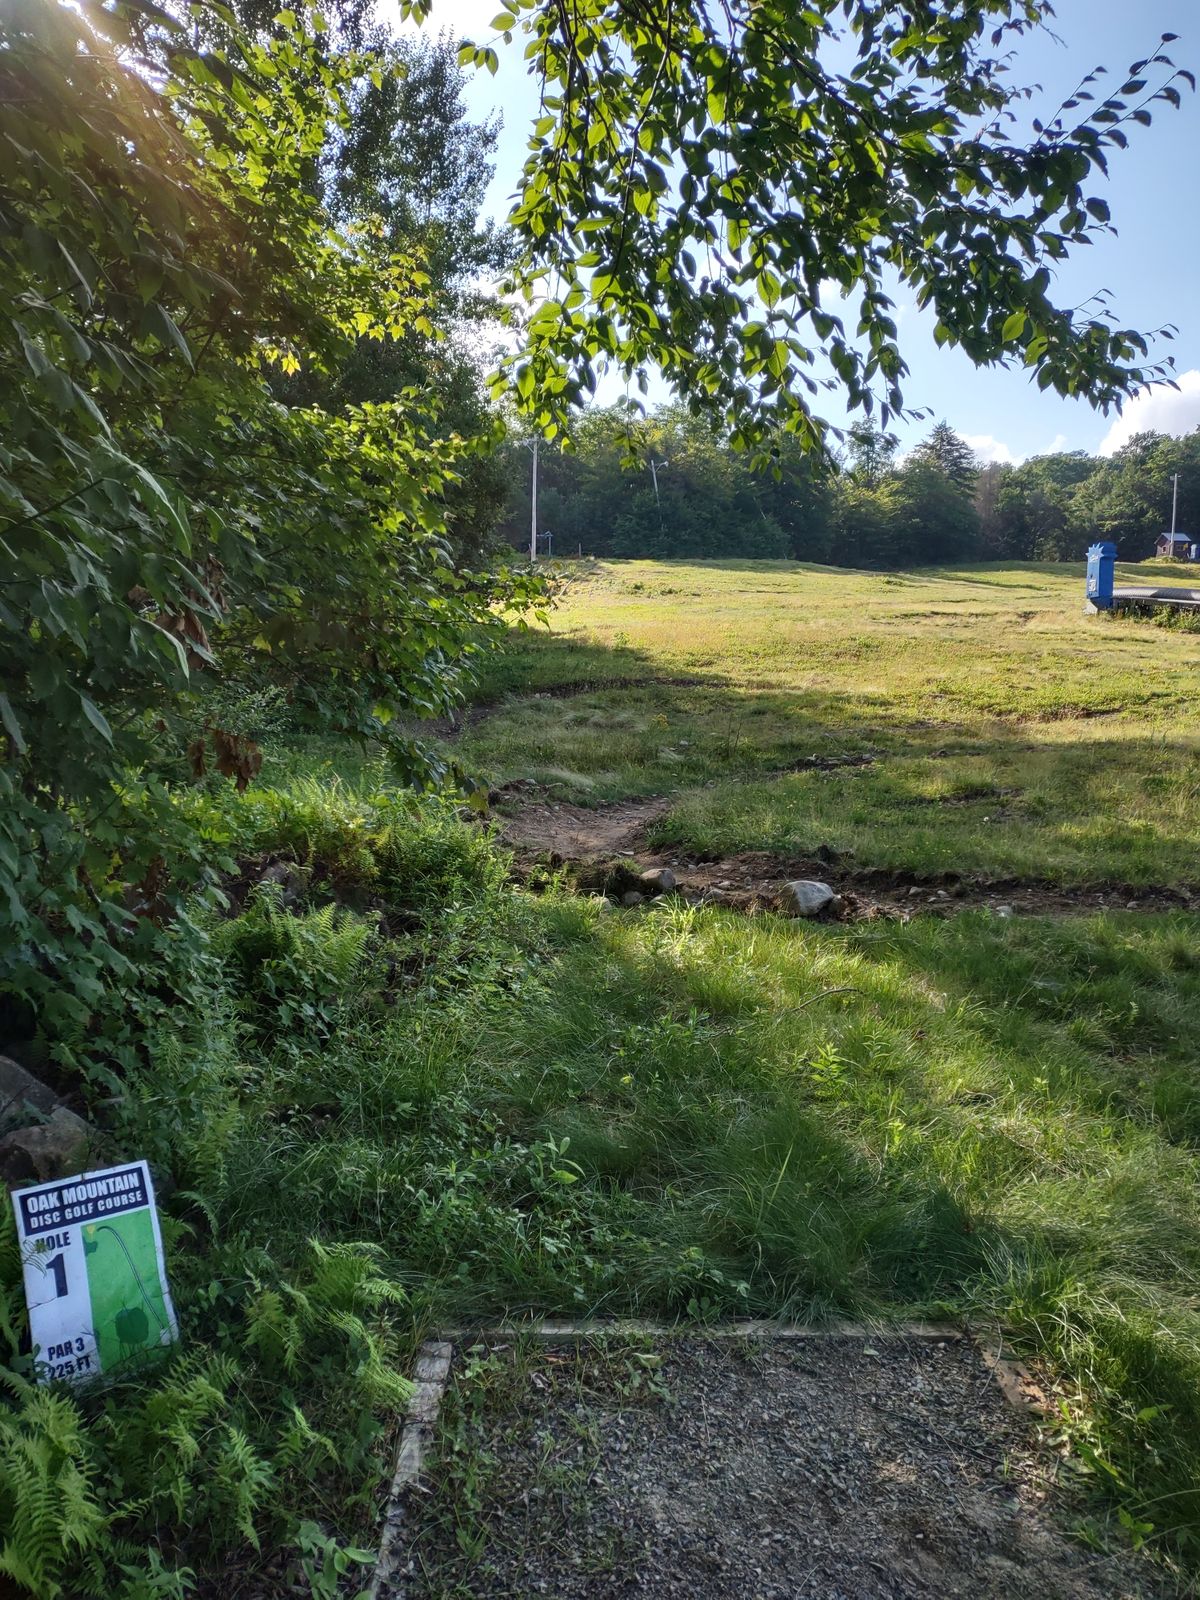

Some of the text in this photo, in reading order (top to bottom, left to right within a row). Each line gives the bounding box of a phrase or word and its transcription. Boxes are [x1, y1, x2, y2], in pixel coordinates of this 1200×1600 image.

[27, 1172, 139, 1214] OAK MOUNTAIN
[30, 1190, 143, 1229] DISC GOLF COURSE
[45, 1253, 69, 1298] 1
[47, 1337, 85, 1361] PAR 3
[48, 1354, 91, 1381] 225 FT
